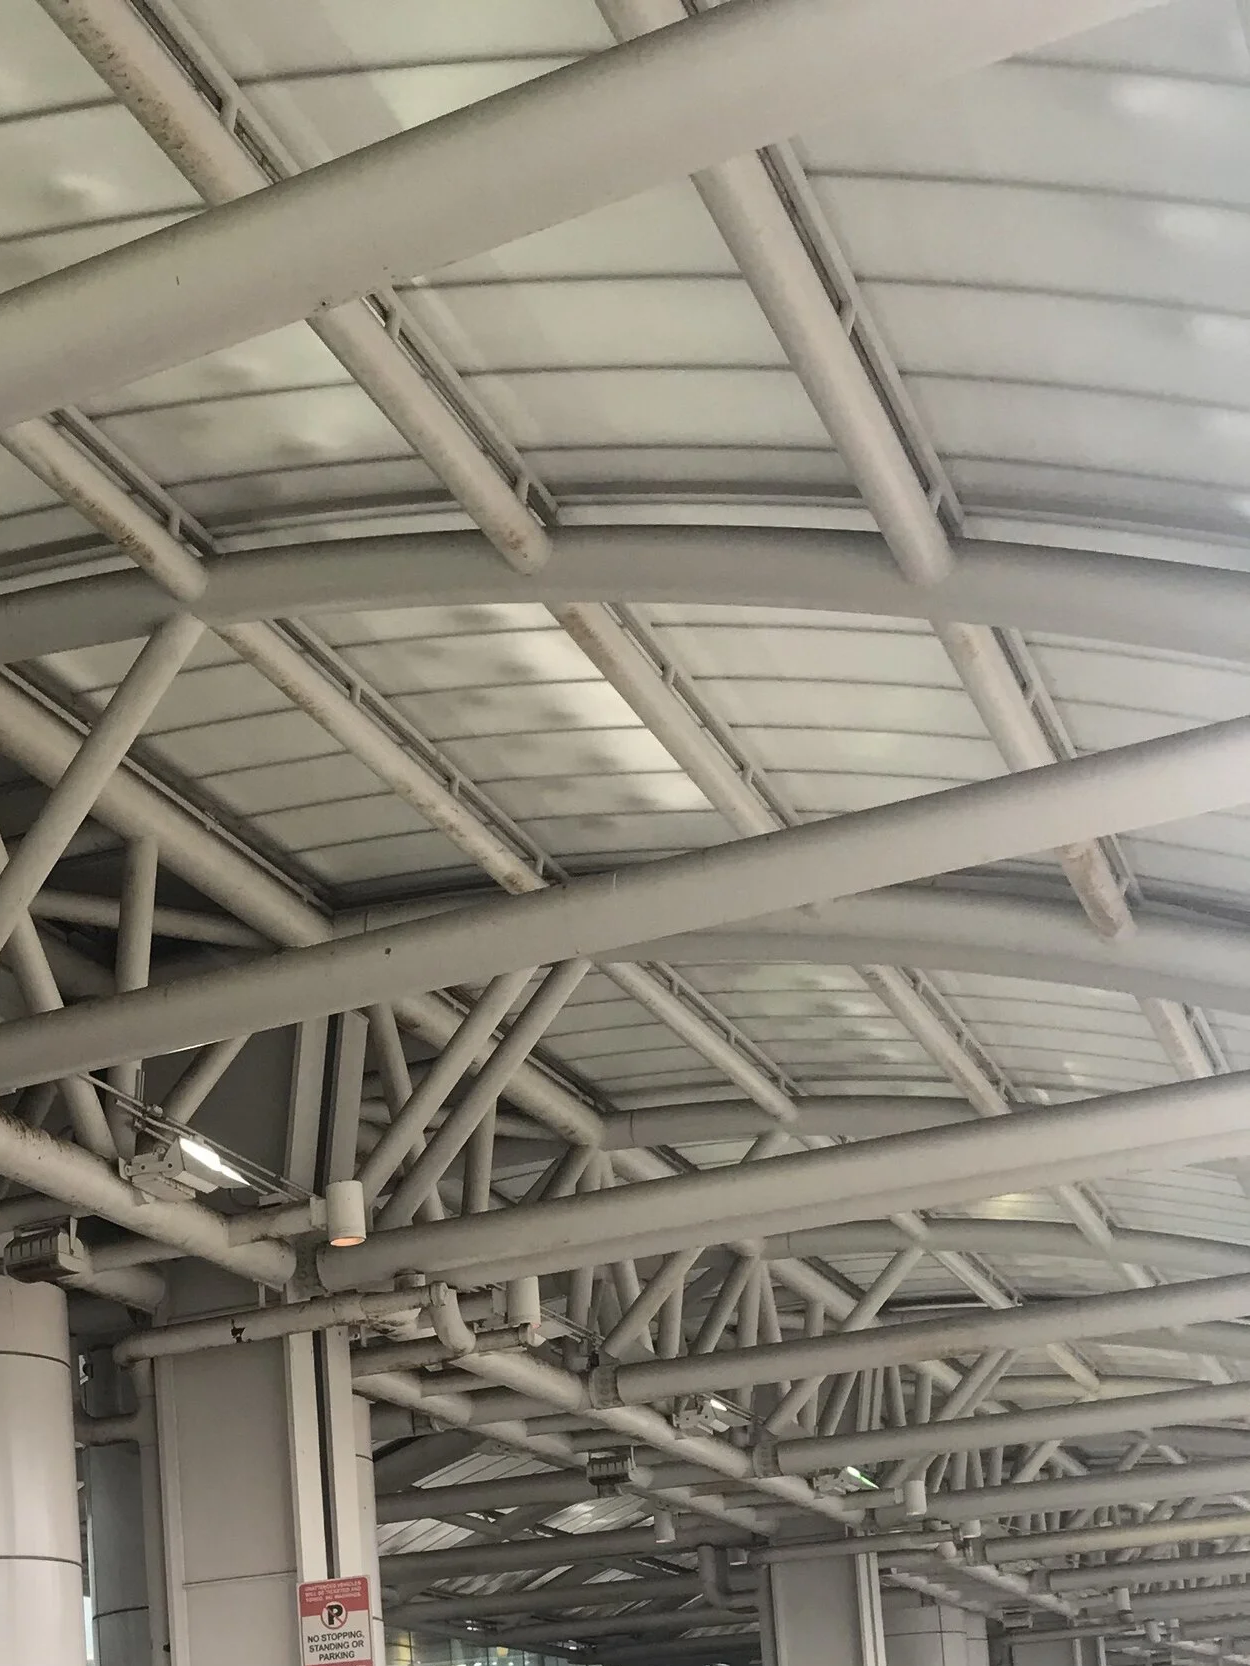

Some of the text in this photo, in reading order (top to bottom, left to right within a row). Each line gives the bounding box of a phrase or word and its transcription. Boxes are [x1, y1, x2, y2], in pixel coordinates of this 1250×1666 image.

[307, 1635, 320, 1643] NO
[309, 1640, 364, 1653] STANDING OR
[319, 1650, 355, 1661] PARKING
